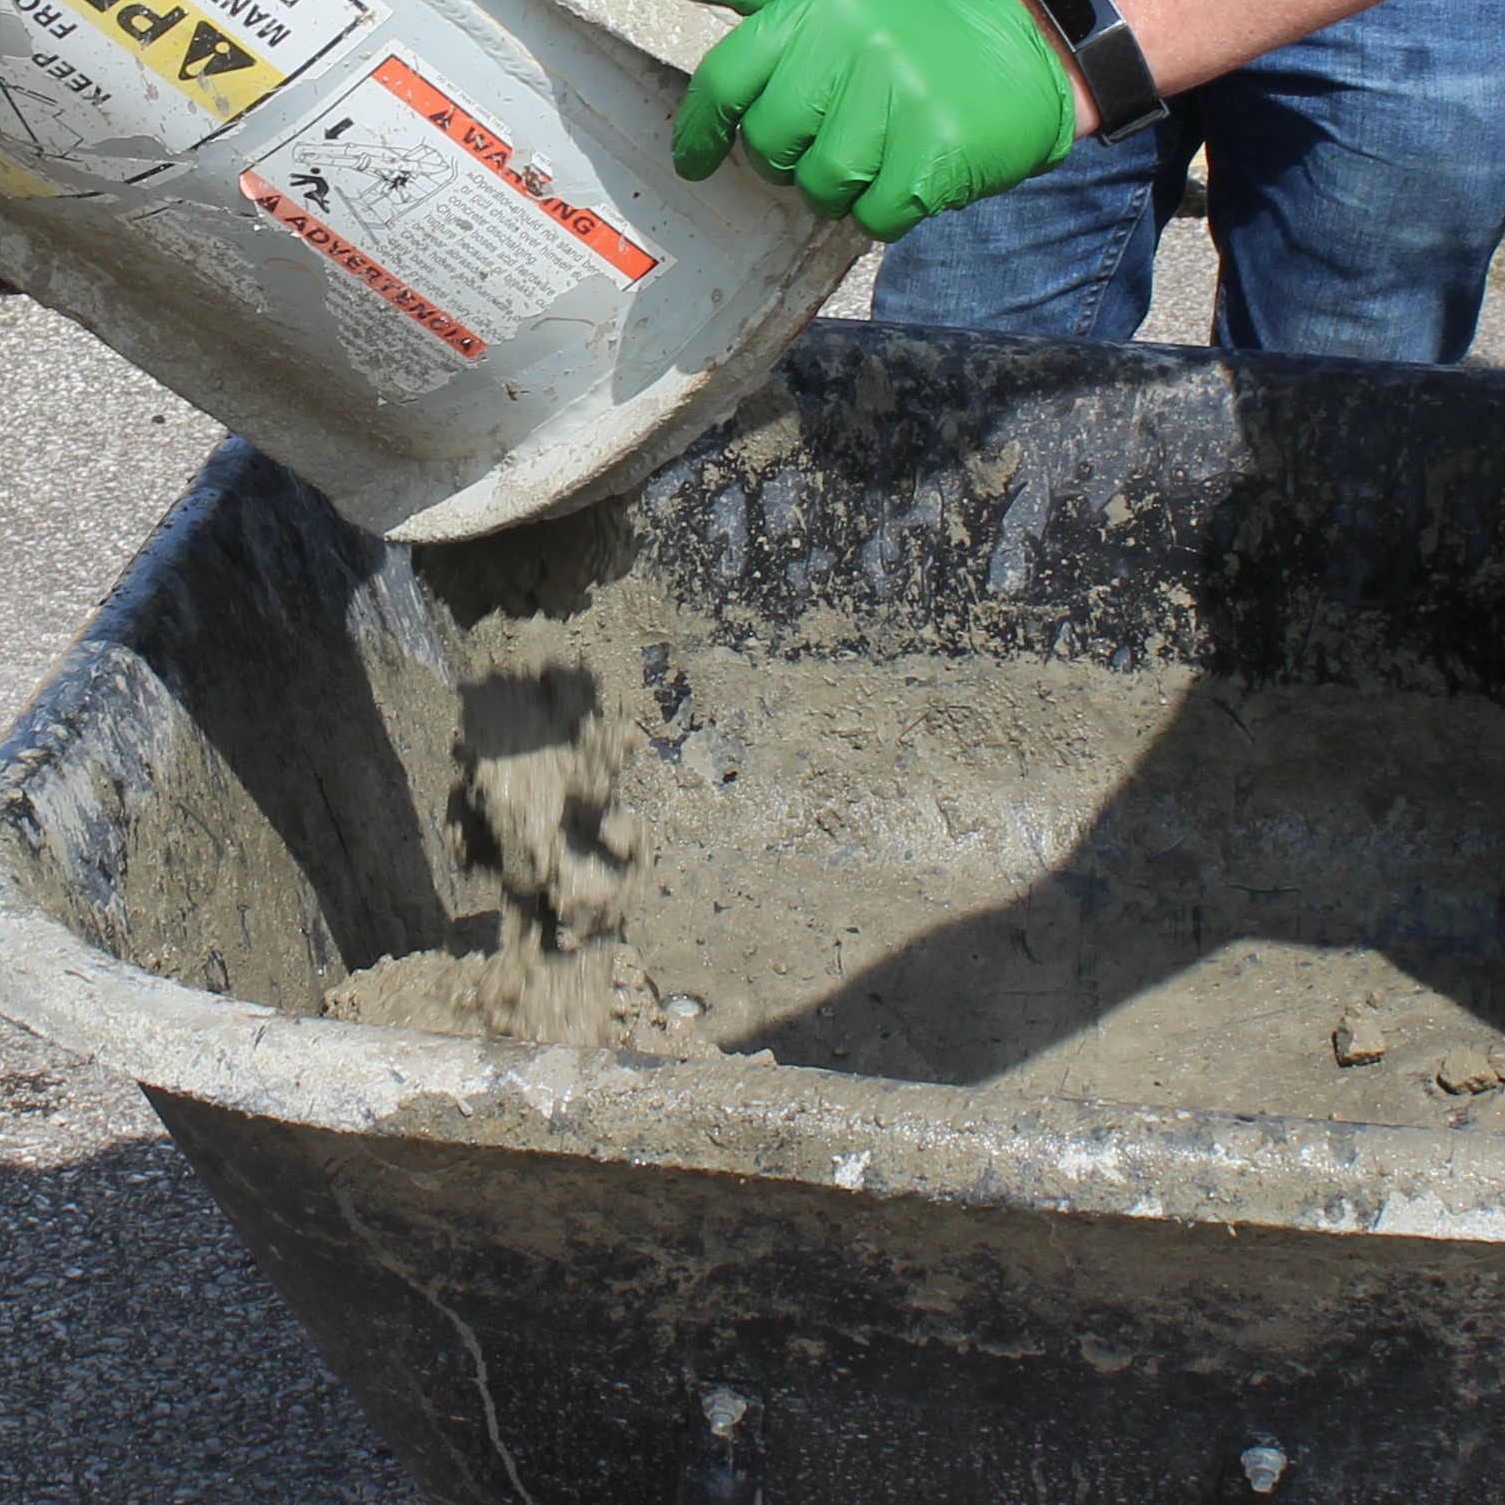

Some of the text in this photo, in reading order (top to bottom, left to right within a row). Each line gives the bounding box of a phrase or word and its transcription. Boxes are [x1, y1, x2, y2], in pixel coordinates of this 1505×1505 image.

[29, 42, 112, 111] KEEP
[459, 124, 598, 239] WAING
[488, 205, 521, 234] chutes
[517, 229, 541, 250] over
[538, 243, 573, 274] himself
[510, 203, 544, 232] should
[540, 226, 558, 243] not
[555, 238, 584, 264] stand
[283, 202, 477, 360] ADVERTENCIA
